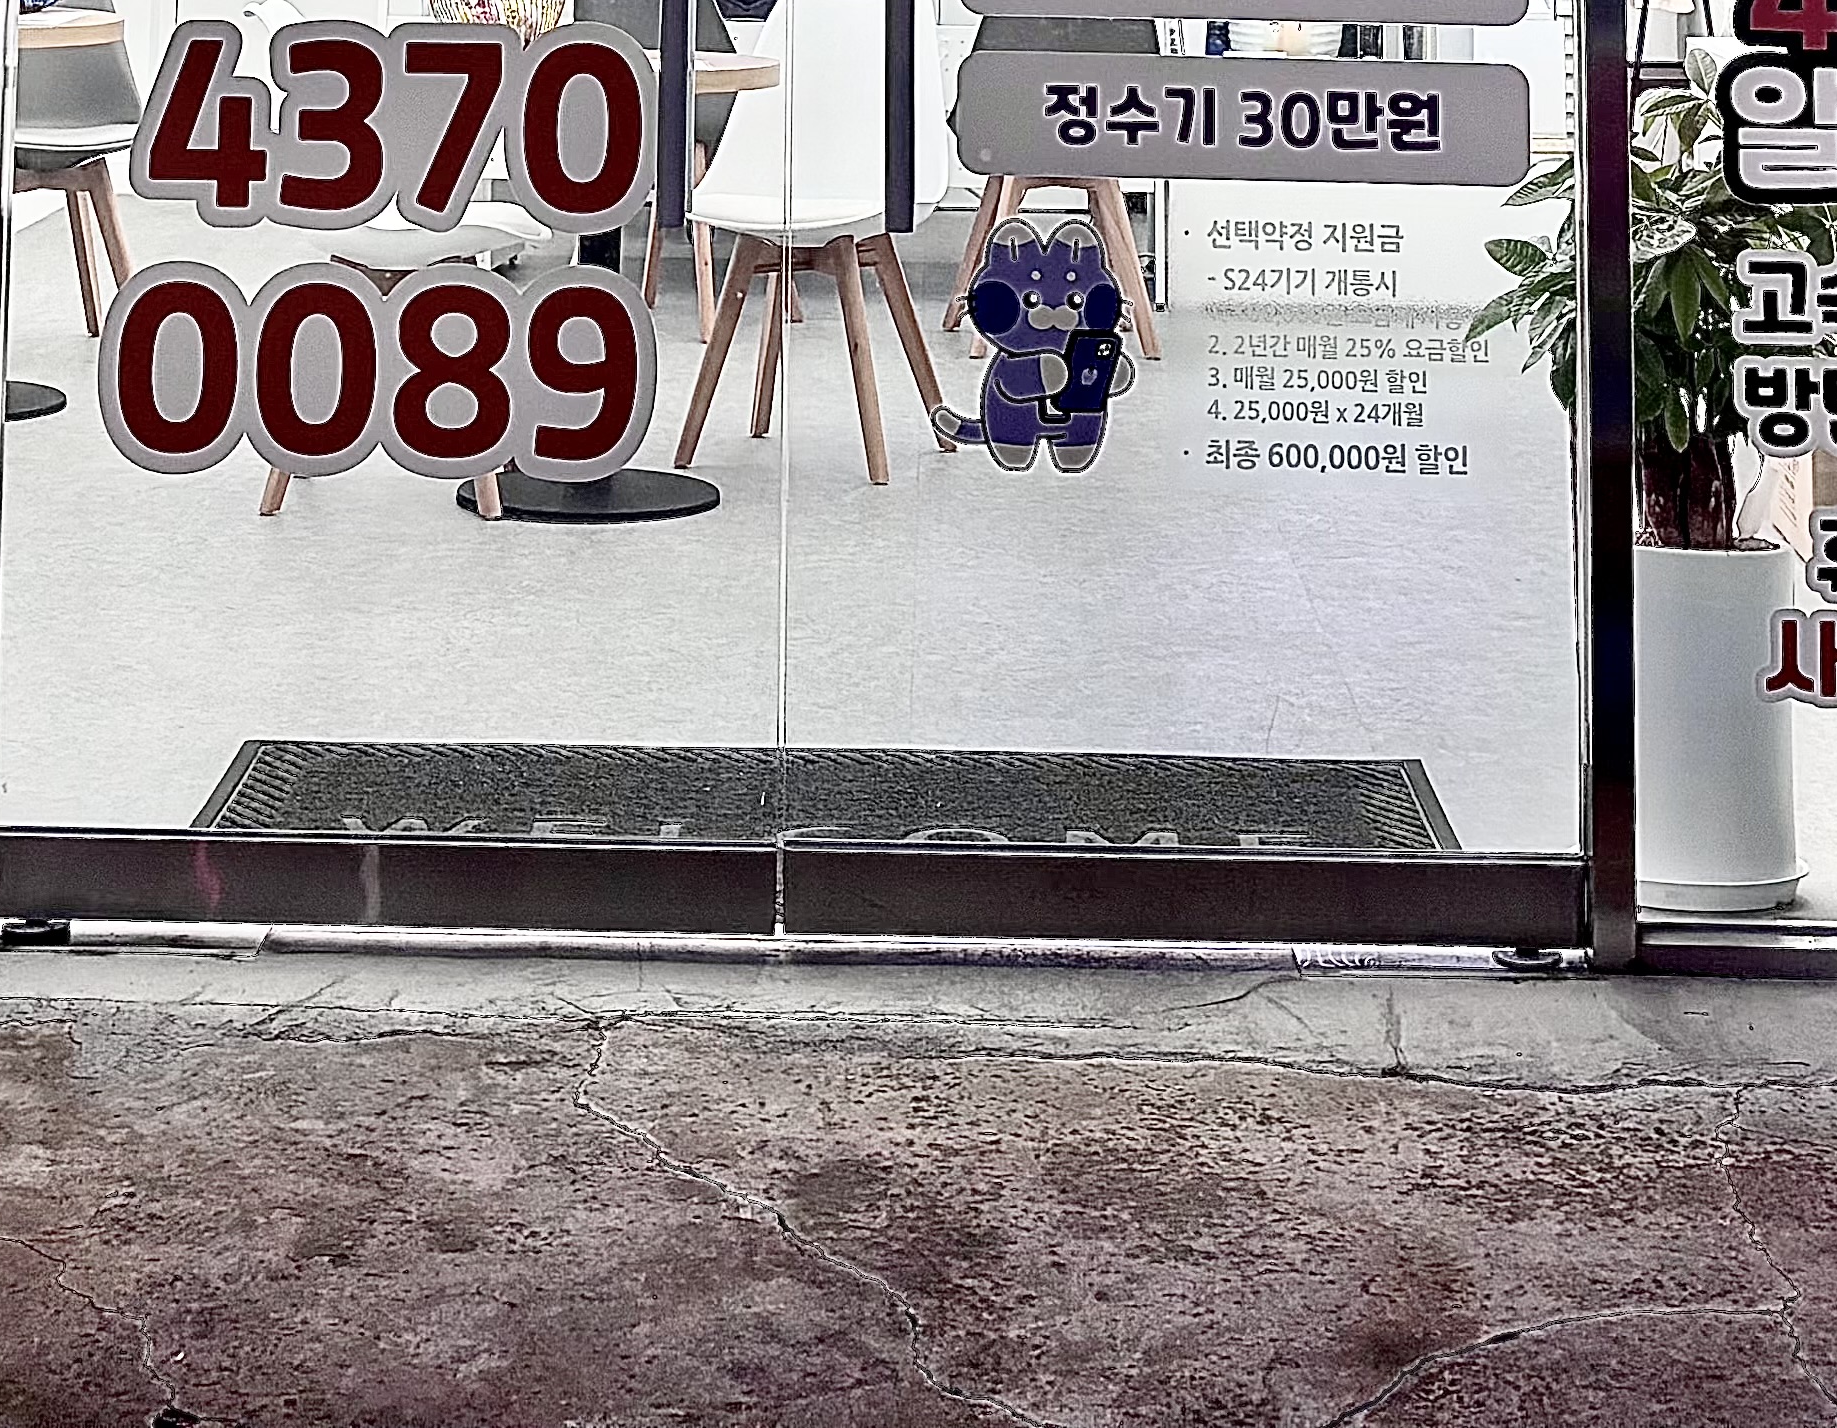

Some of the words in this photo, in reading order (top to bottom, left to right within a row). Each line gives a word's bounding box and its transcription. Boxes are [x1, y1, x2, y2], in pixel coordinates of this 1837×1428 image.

[148, 38, 643, 215] 4370
[1043, 83, 1217, 149] 정수기
[1237, 90, 1443, 154] 30만원
[1206, 219, 1313, 252] 선택약정
[1322, 222, 1405, 253] 지원금
[1222, 267, 1316, 296] S24기기
[1324, 268, 1398, 298] 개통시
[1296, 334, 1339, 361] 매월
[1345, 336, 1396, 360] 25%
[116, 282, 638, 462] 0089
[1233, 365, 1276, 392] 매월
[1282, 368, 1379, 395] 25,000원
[1385, 369, 1429, 395] 할인
[1233, 399, 1330, 426] 25,000원
[1352, 401, 1425, 428] 24개월
[1205, 438, 1261, 471] 최종
[1267, 442, 1407, 474] 600,000원
[1415, 444, 1469, 476] 할인
